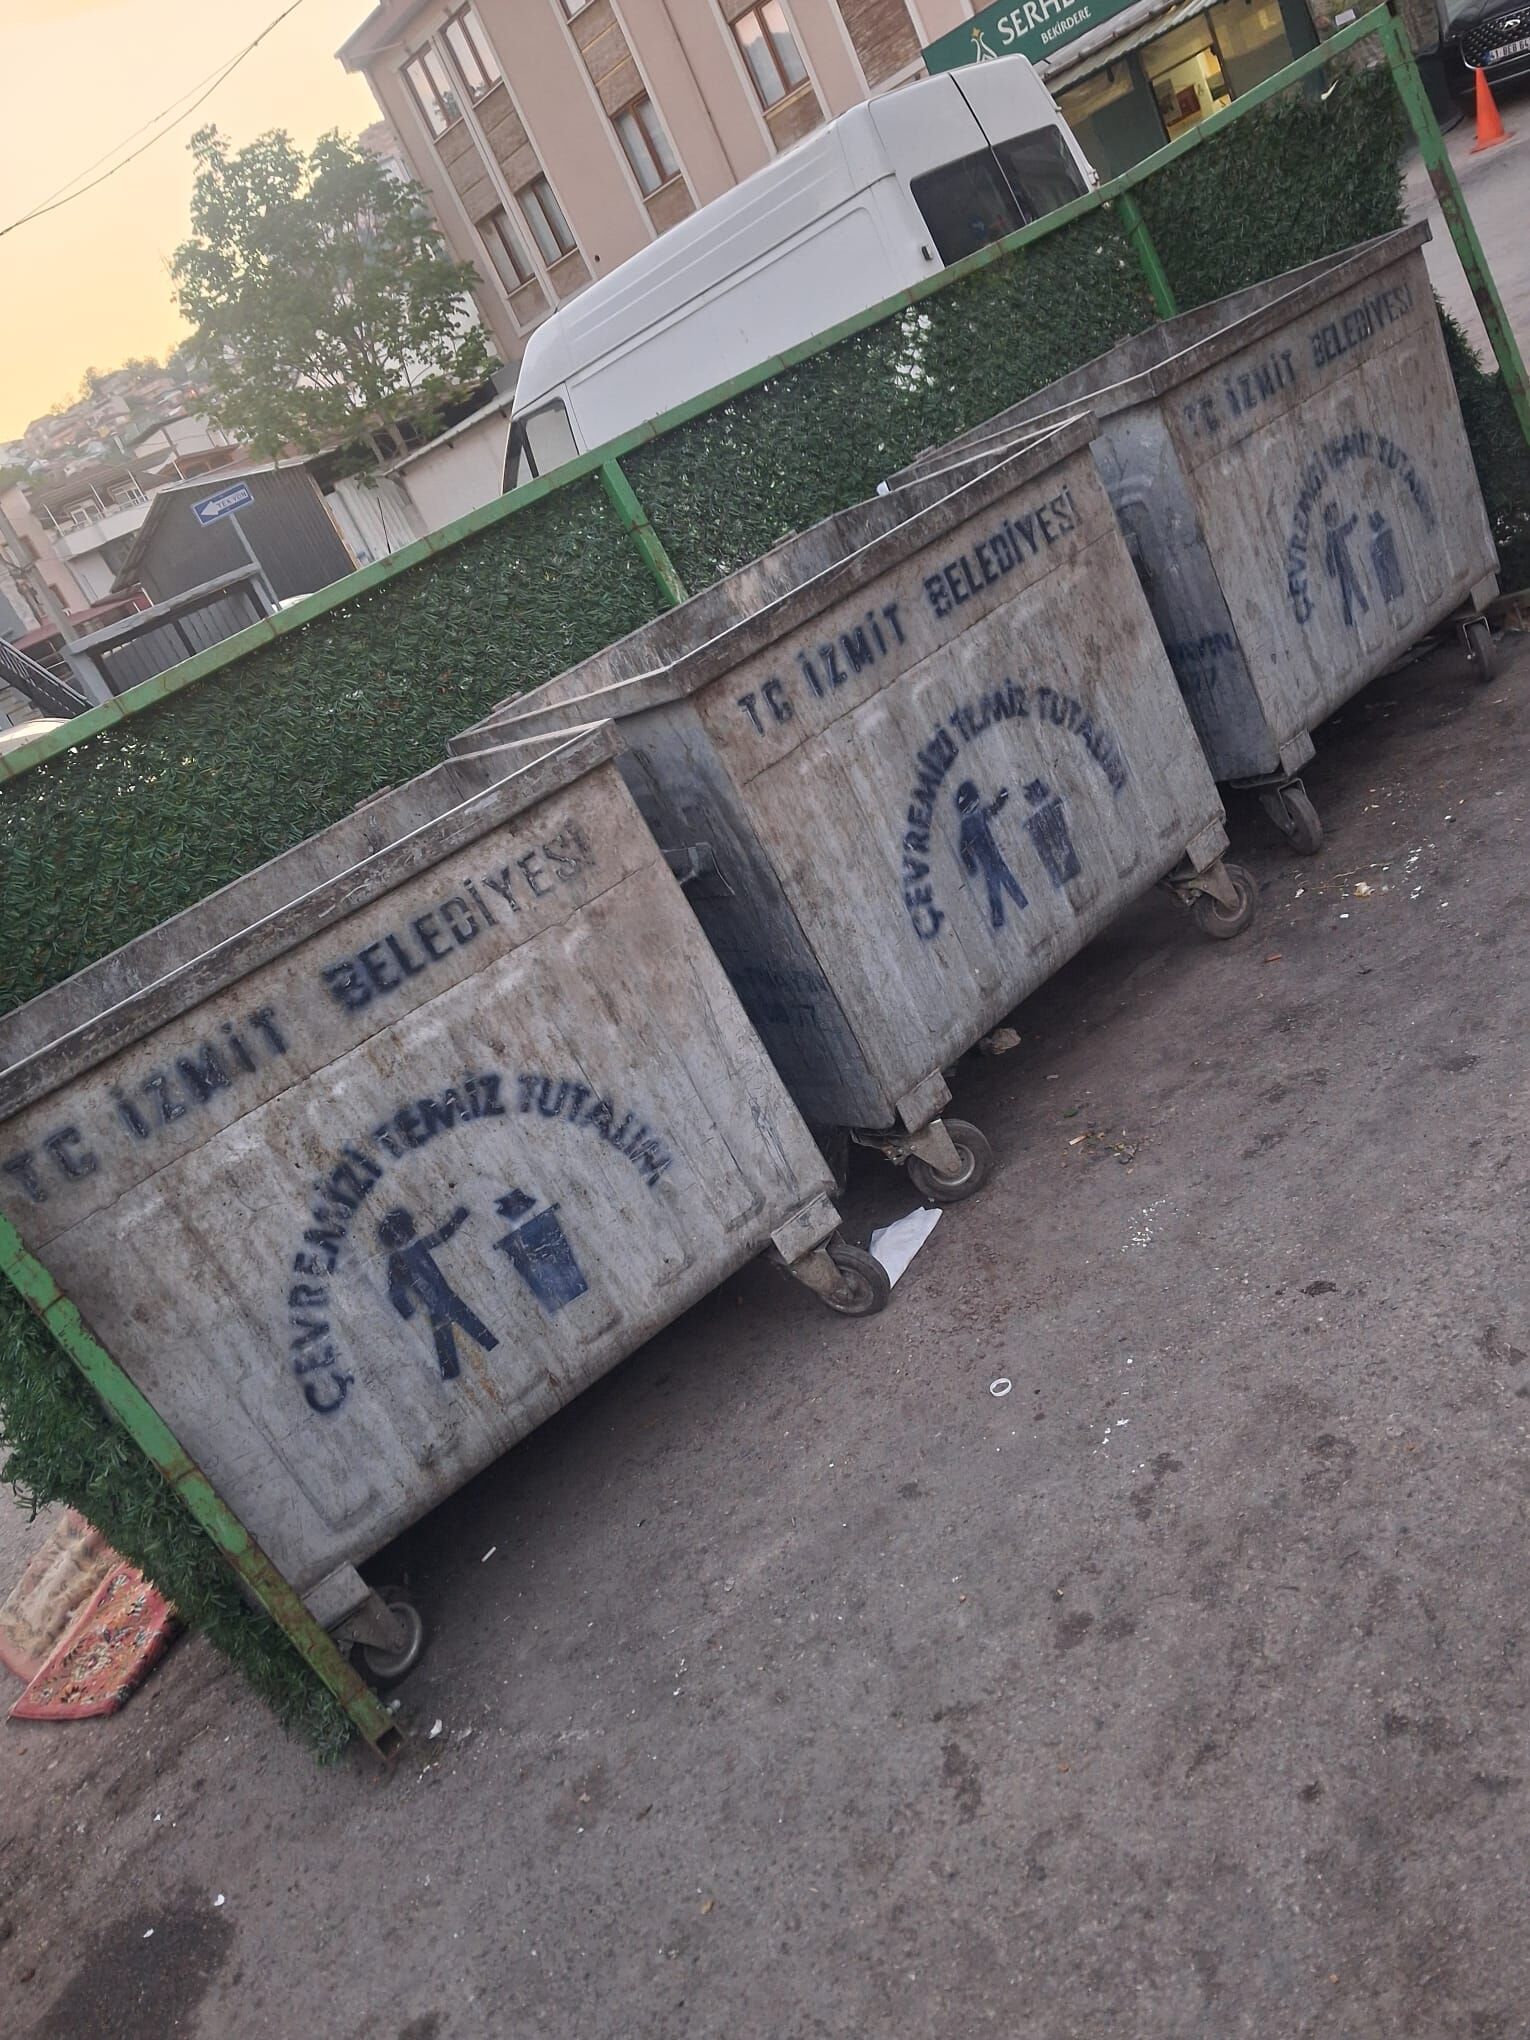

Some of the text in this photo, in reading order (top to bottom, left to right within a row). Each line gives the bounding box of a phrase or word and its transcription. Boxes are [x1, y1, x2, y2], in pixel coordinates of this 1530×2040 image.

[1041, 6, 1092, 44] BEKİRDERE
[1222, 350, 1296, 418] İZMİT
[795, 603, 905, 698] İZMİT
[923, 484, 1083, 619] BELEDİYESİ
[3, 1126, 97, 1202] TC
[109, 1006, 288, 1141] İZMİT
[320, 816, 596, 1013] BELEDİYESİ
[287, 1071, 673, 1414] ÇEVREMİZİ TEMİZ TUTALIM
